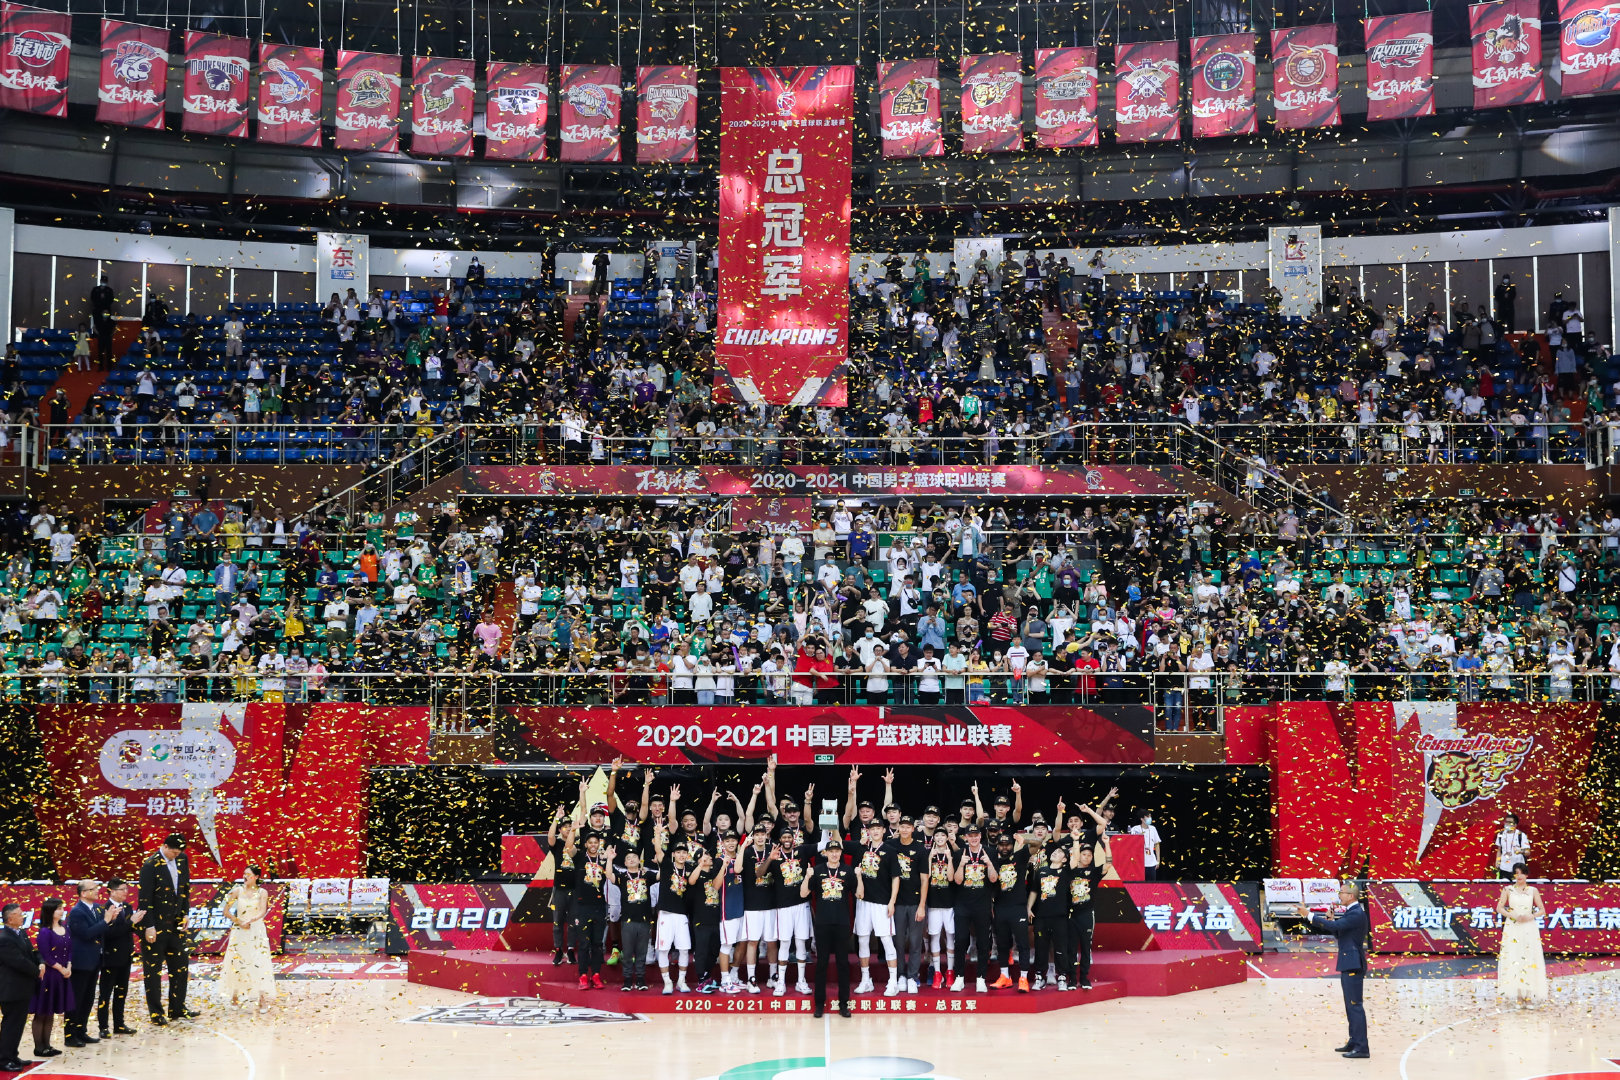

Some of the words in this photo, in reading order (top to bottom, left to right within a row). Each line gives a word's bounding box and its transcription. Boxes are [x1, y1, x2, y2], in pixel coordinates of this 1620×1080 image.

[760, 148, 805, 301] 总冠军
[332, 247, 353, 267] 东
[723, 328, 840, 345] CHAMPIONS
[852, 472, 1006, 489] 中国男子篮球职业联赛
[636, 724, 778, 747] 2020-2021
[785, 724, 1013, 747] 中国男子篮球职业联赛
[410, 907, 510, 930] 2020
